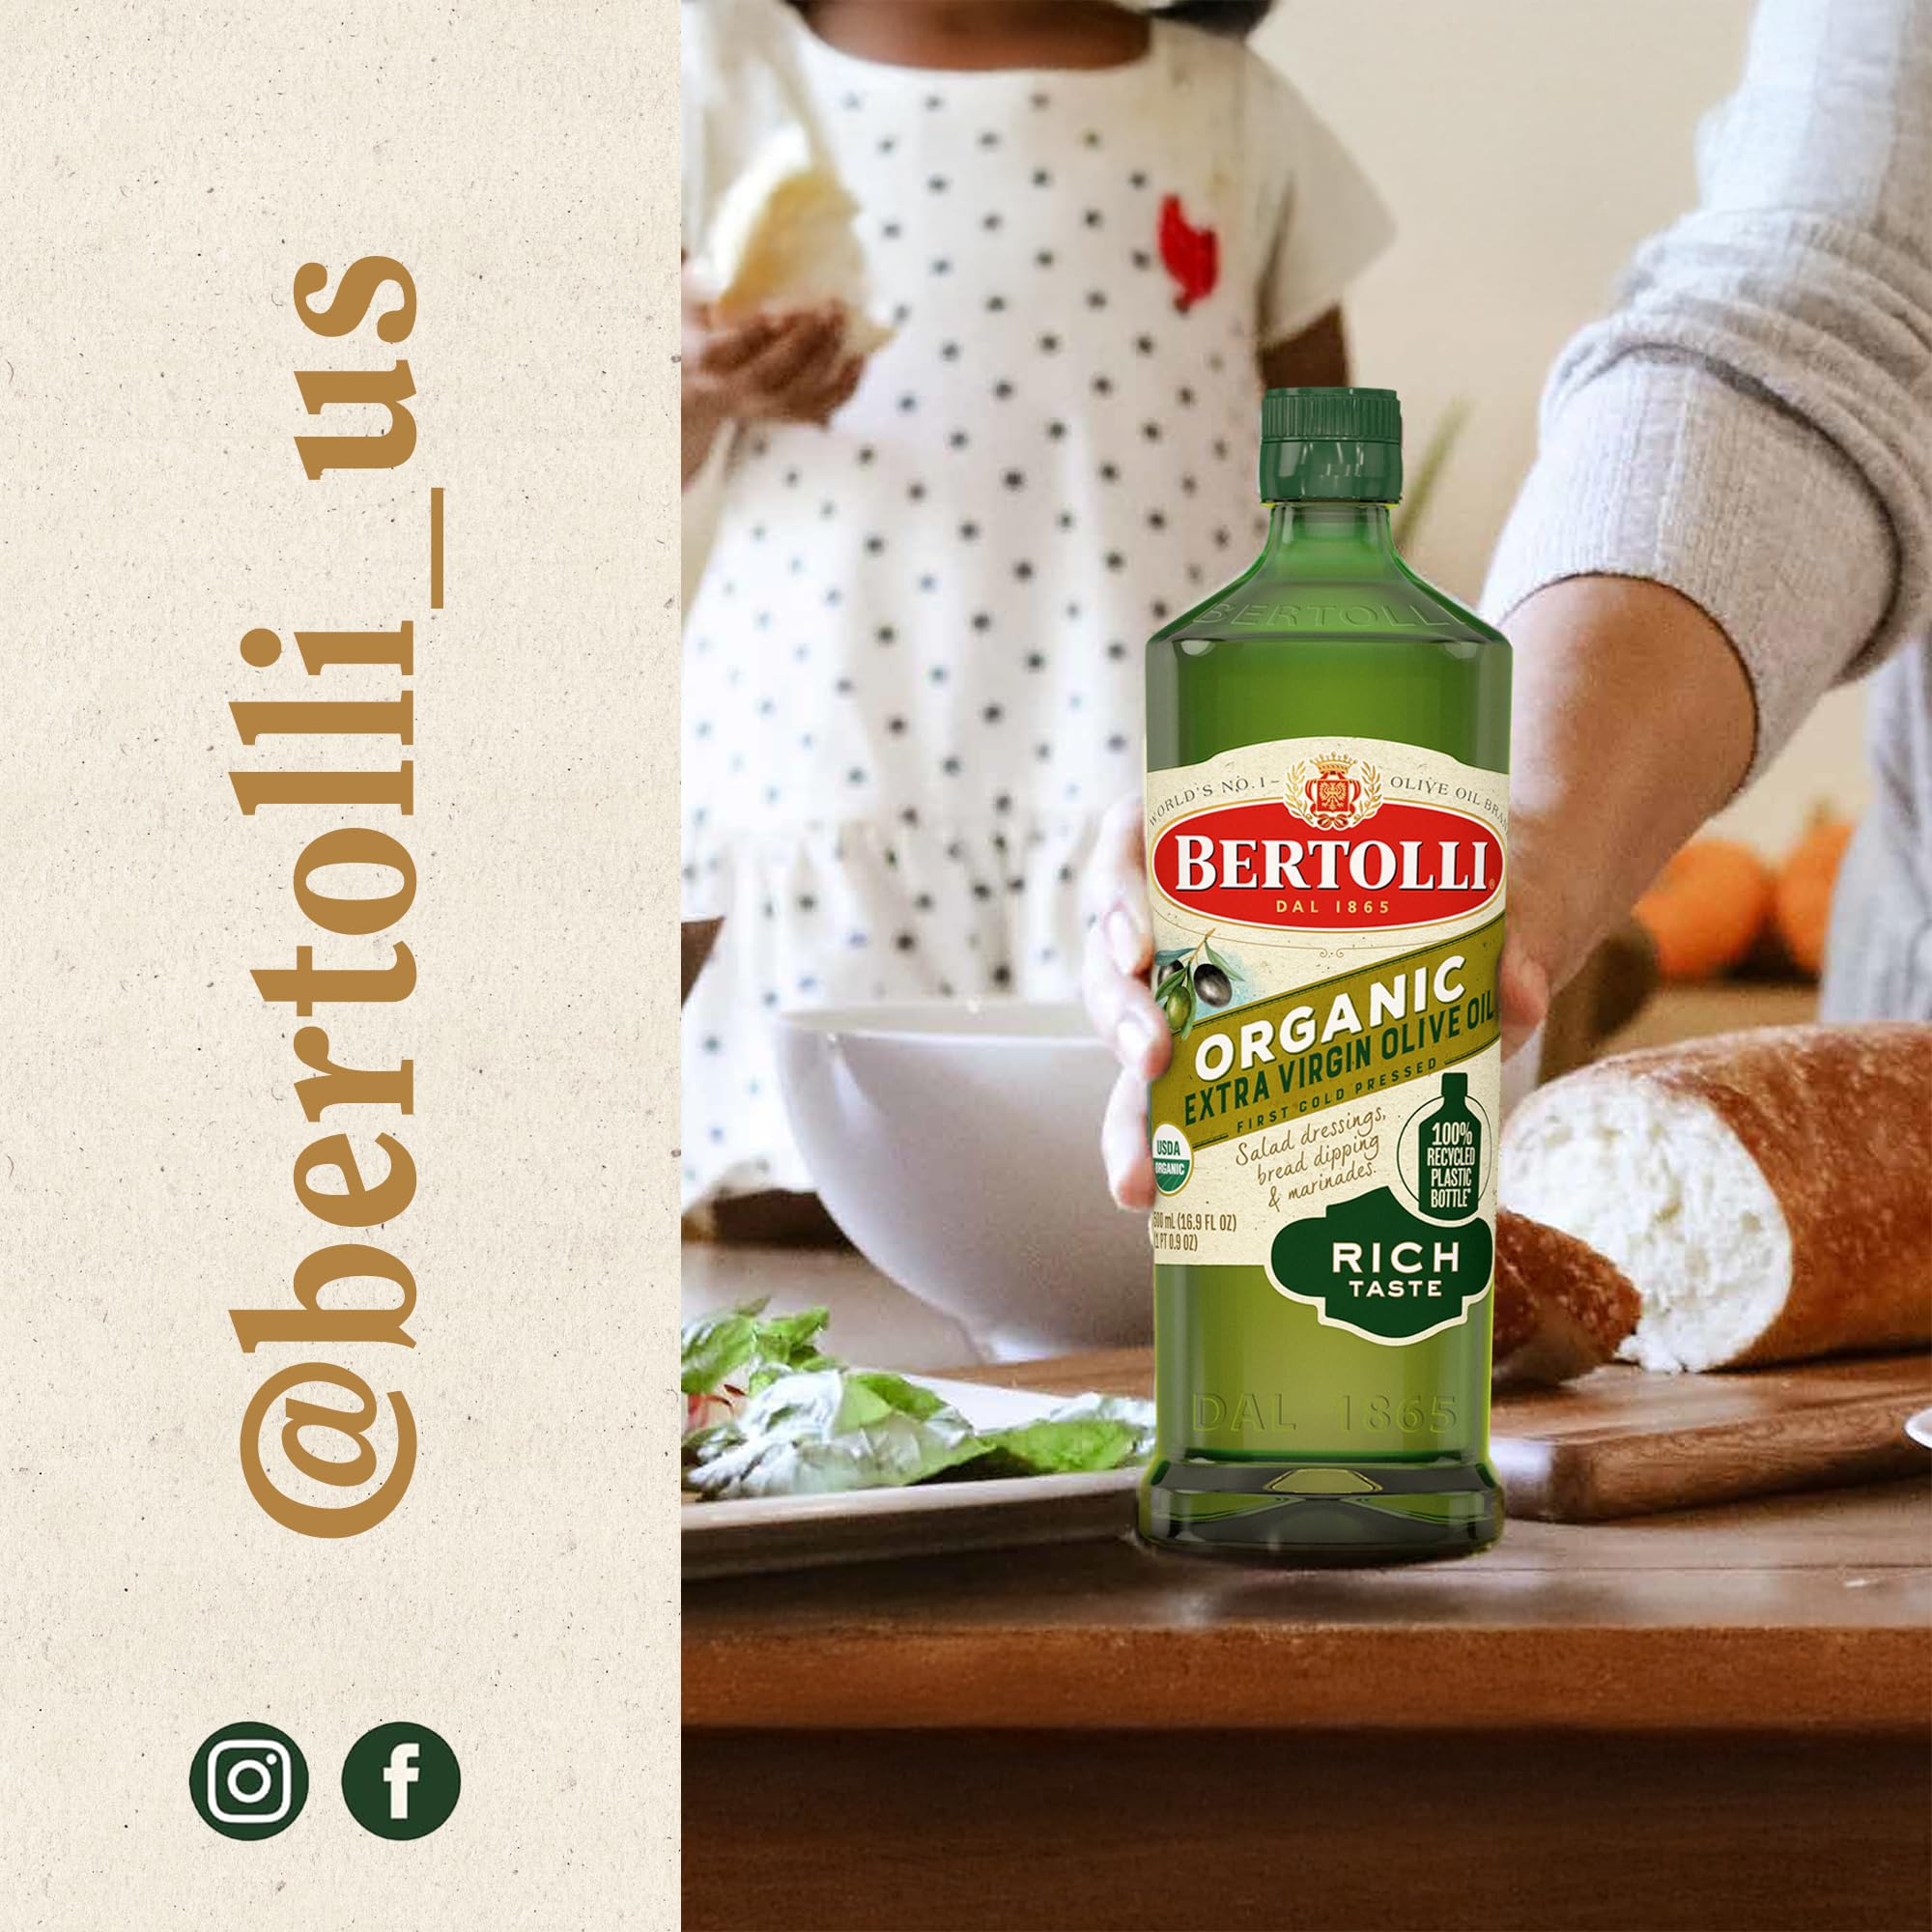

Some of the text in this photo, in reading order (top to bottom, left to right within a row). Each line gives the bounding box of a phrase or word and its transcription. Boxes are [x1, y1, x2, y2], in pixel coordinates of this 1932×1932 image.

[1150, 784, 1213, 826] WORLD'S
[1390, 777, 1449, 795] OLIVE
[1455, 787, 1480, 806] OIL
[1484, 799, 1508, 835] BRAN
[1175, 835, 1489, 891] BERTOLLI
[1276, 899, 1390, 914] DAL 1865
[1195, 955, 1466, 1083] ORGANIC
[1184, 989, 1493, 1126] EXTRA VIRGIN OLIVE OIL
[1236, 1057, 1436, 1134] FIRST COLD PRESSED
[1156, 1140, 1180, 1155] USDA
[1236, 1106, 1386, 1166] Salad dressings,
[1431, 1122, 1473, 1146] 100%
[1154, 1162, 1185, 1175] ORGANIC
[1257, 1135, 1379, 1186] bread dipping
[1427, 1147, 1476, 1167] RECYCLED
[1267, 1160, 1377, 1212] & marinades.
[1431, 1167, 1472, 1187] PLASTIC
[1177, 1212, 1202, 1231] (16.9
[1205, 1213, 1216, 1231] FL
[1219, 1213, 1236, 1233] OZ)
[1160, 1232, 1168, 1249] PT
[1169, 1233, 1180, 1250] 0.9
[1183, 1233, 1198, 1252] OZ)
[1332, 1241, 1460, 1274] RICH
[1349, 1280, 1442, 1297] TASTE
[1192, 1392, 1458, 1434] DAL 1865
